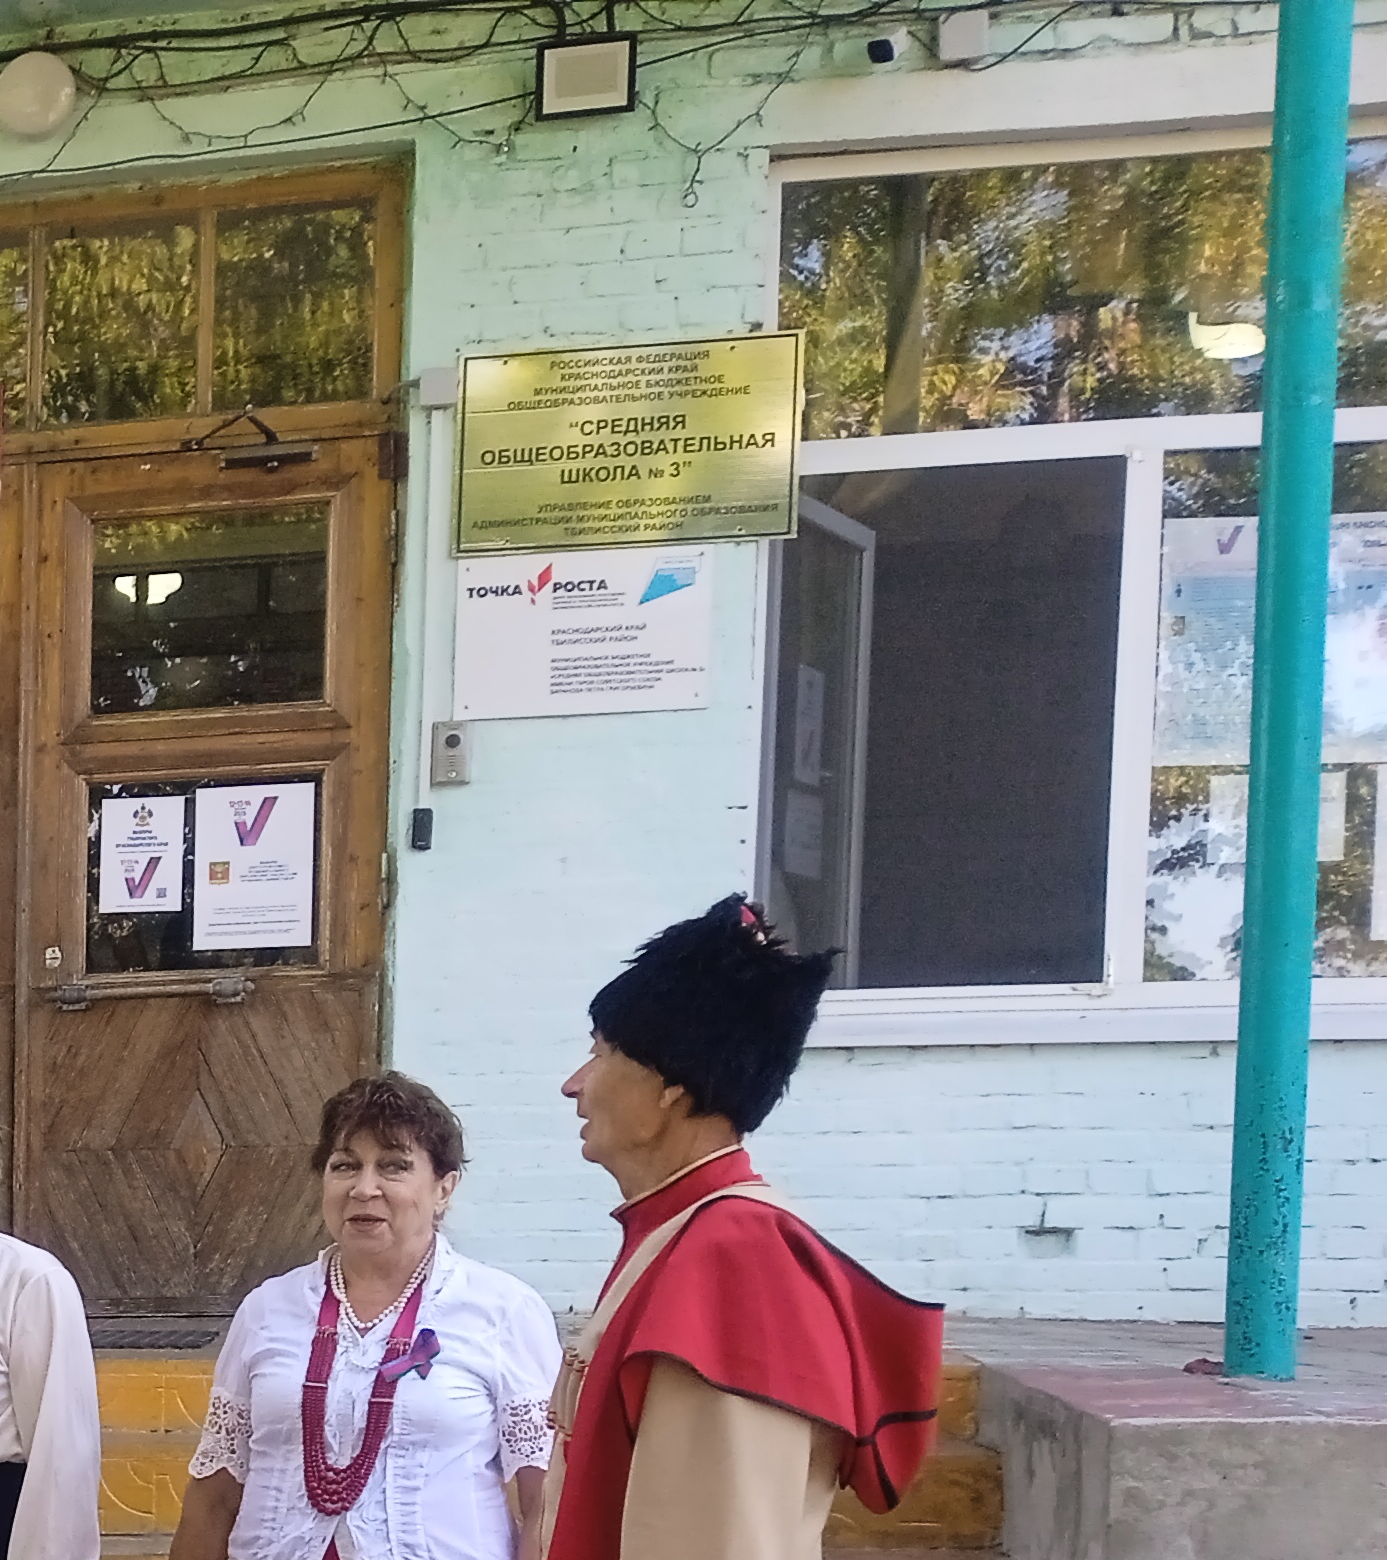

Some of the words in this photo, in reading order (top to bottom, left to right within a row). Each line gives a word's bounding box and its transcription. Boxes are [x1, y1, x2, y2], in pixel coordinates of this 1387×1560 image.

[549, 355, 632, 371] РОССИЙСКАЯ
[636, 350, 710, 365] ФЕДЕРАЦИЯ
[561, 365, 664, 382] КРАСНОДАРСКИЙ
[667, 362, 698, 376] КРАЙ
[534, 379, 641, 396] МУНИЦИПАЛЬНОЕ
[646, 374, 725, 389] БЮДЖЕТНОЕ
[507, 391, 664, 412] ОБЩЕОБРАЗОВАТЕЛЬНОЕ
[667, 384, 750, 400] УЧРЕЖДЕНИЕ
[481, 432, 775, 466] ОБЩЕОБРАЗОВАТЕЛЬНАЯ
[561, 464, 642, 485] ШКОЛА
[648, 466, 665, 479] №
[537, 500, 613, 513] УПРАВЛЕНИЕ
[615, 494, 712, 509] ОБРАЗОВАНИЕМ
[643, 521, 684, 532] РАЙОН
[467, 584, 523, 599] ТОЧКА
[552, 579, 608, 593] РОСТА
